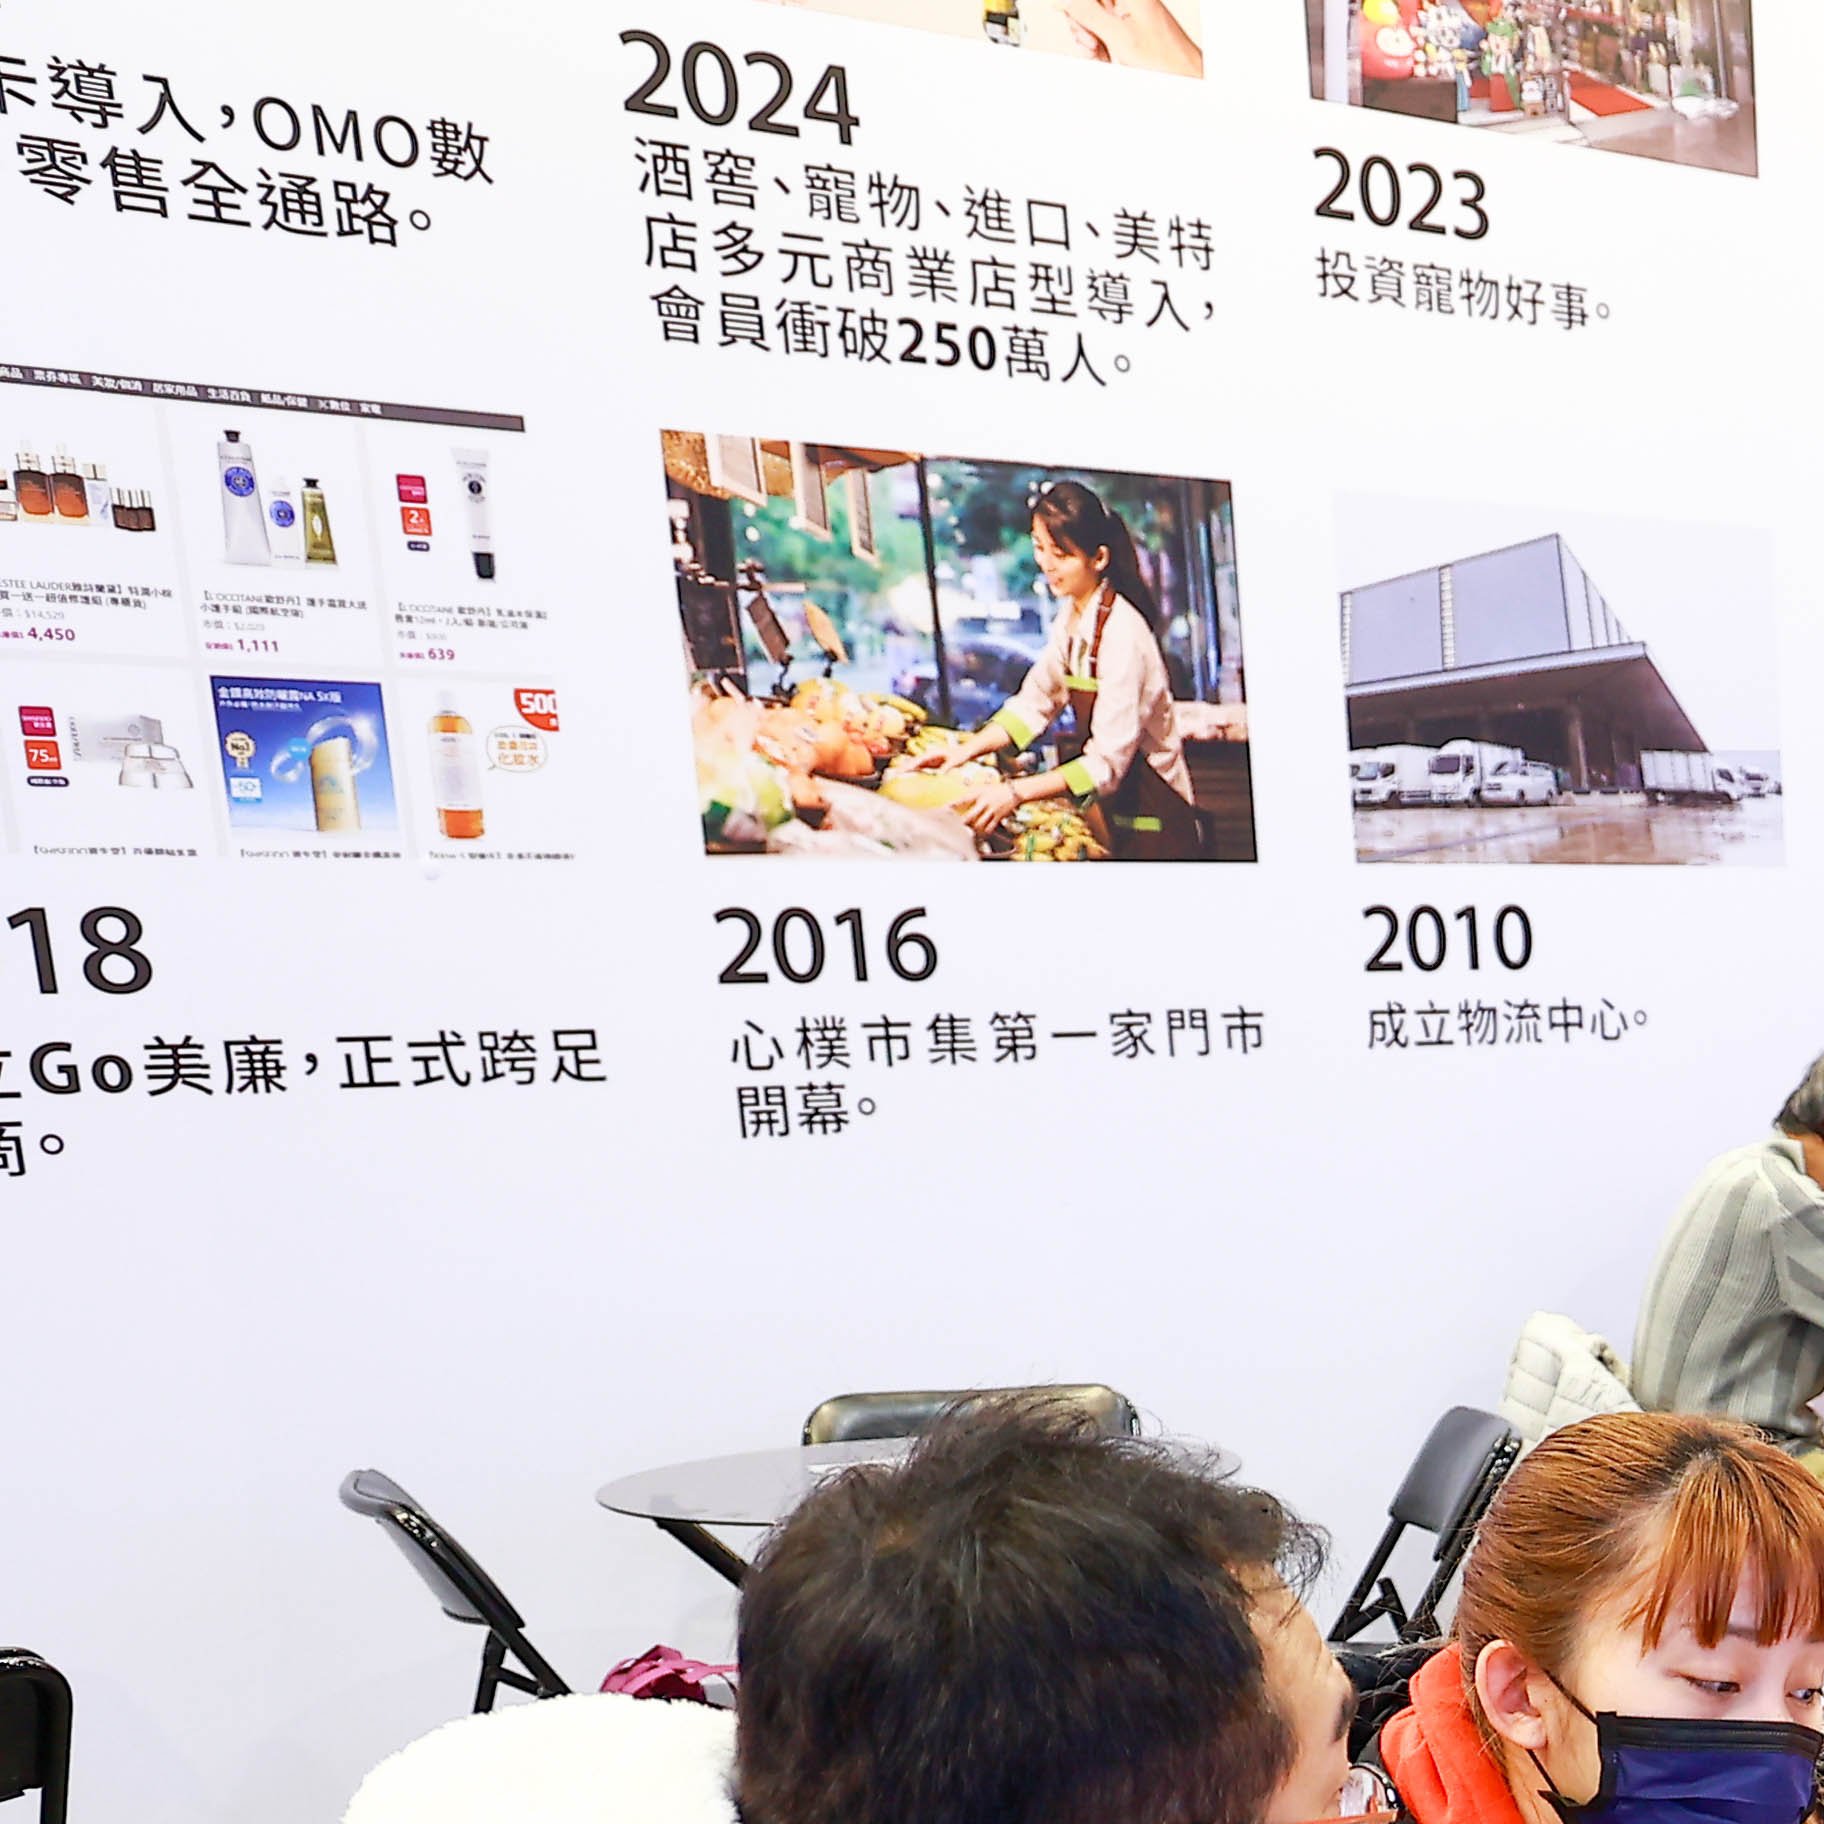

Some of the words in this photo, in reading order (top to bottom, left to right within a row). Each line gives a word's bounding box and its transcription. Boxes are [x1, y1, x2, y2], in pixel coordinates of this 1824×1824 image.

[619, 29, 860, 146] 2024
[16, 134, 431, 248] 零售全通路。
[634, 136, 1215, 274] 酒窖、寵物、進口、美特
[1313, 147, 1490, 240] 2023
[645, 213, 1215, 334] 店多元商業店型導入，
[1315, 247, 1611, 330] 投資寵物好事。
[649, 283, 1131, 387] 會員衝破250萬人。
[27, 627, 76, 643] 4,450
[428, 648, 455, 661] 639
[6, 906, 153, 995] 18
[712, 906, 938, 984] 2016
[1362, 904, 1534, 972] 2010
[1367, 998, 1648, 1049] 成立物流中心。
[735, 1082, 876, 1140] 開幕。
